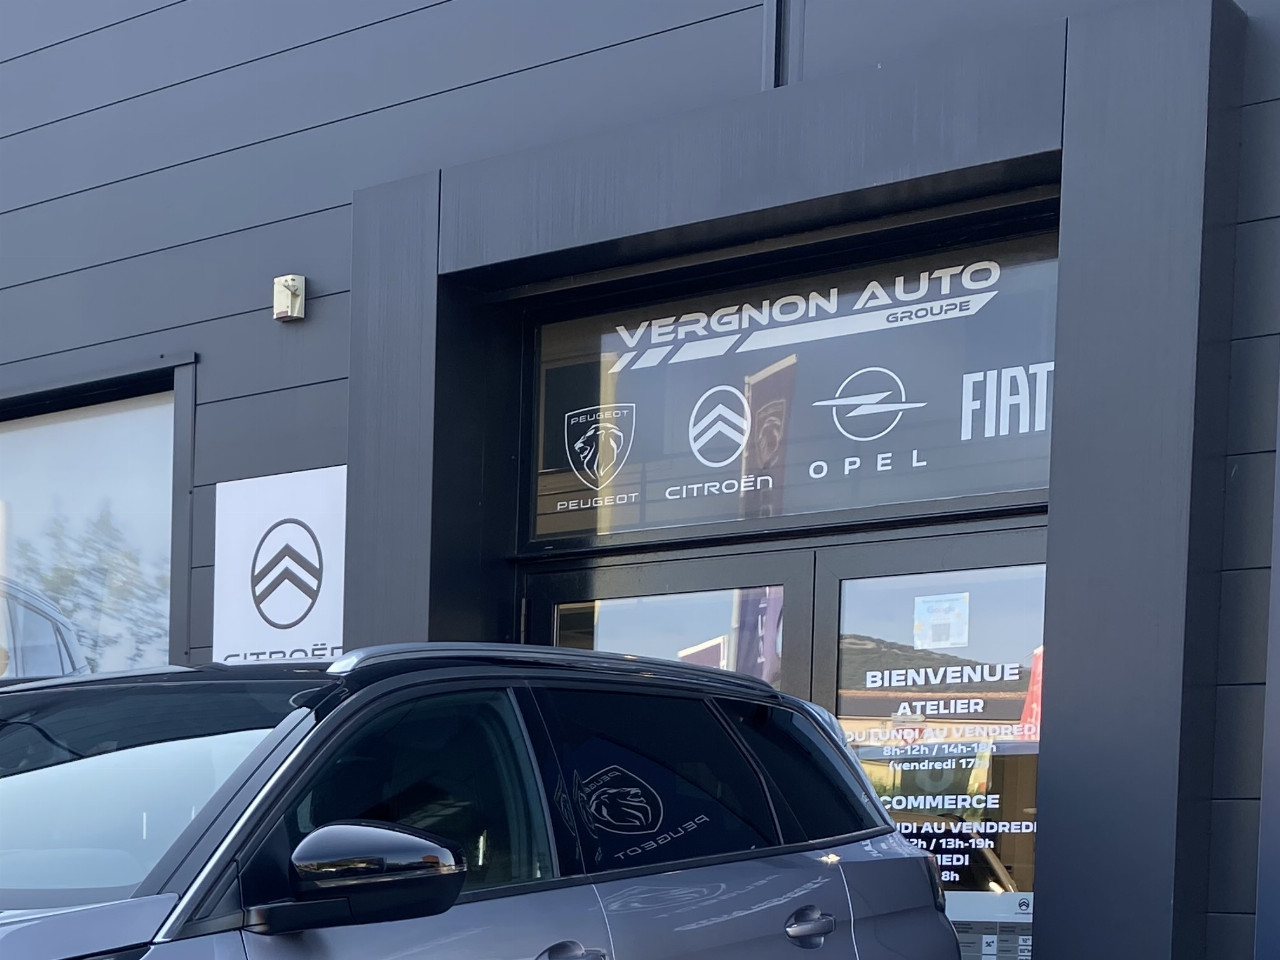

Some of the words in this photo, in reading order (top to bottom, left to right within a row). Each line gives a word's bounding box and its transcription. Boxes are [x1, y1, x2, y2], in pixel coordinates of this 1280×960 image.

[615, 288, 838, 348] VERGNON
[852, 260, 1001, 310] AUTO
[885, 300, 971, 323] GROUPE
[961, 361, 1055, 441] FIAT
[570, 409, 630, 425] PEUGEOT
[808, 449, 927, 479] OPEL
[556, 492, 639, 511] PEUGEOT
[865, 663, 1020, 688] BIENVENUE
[897, 698, 984, 717] ATELIER
[923, 727, 948, 740] AU
[883, 744, 929, 756] 8h-12h
[942, 742, 997, 754] 14h-18h
[889, 758, 956, 771] (vendredi
[879, 794, 1000, 810] COMMERCE
[921, 821, 946, 834] AU
[939, 838, 995, 849] 13h-19h
